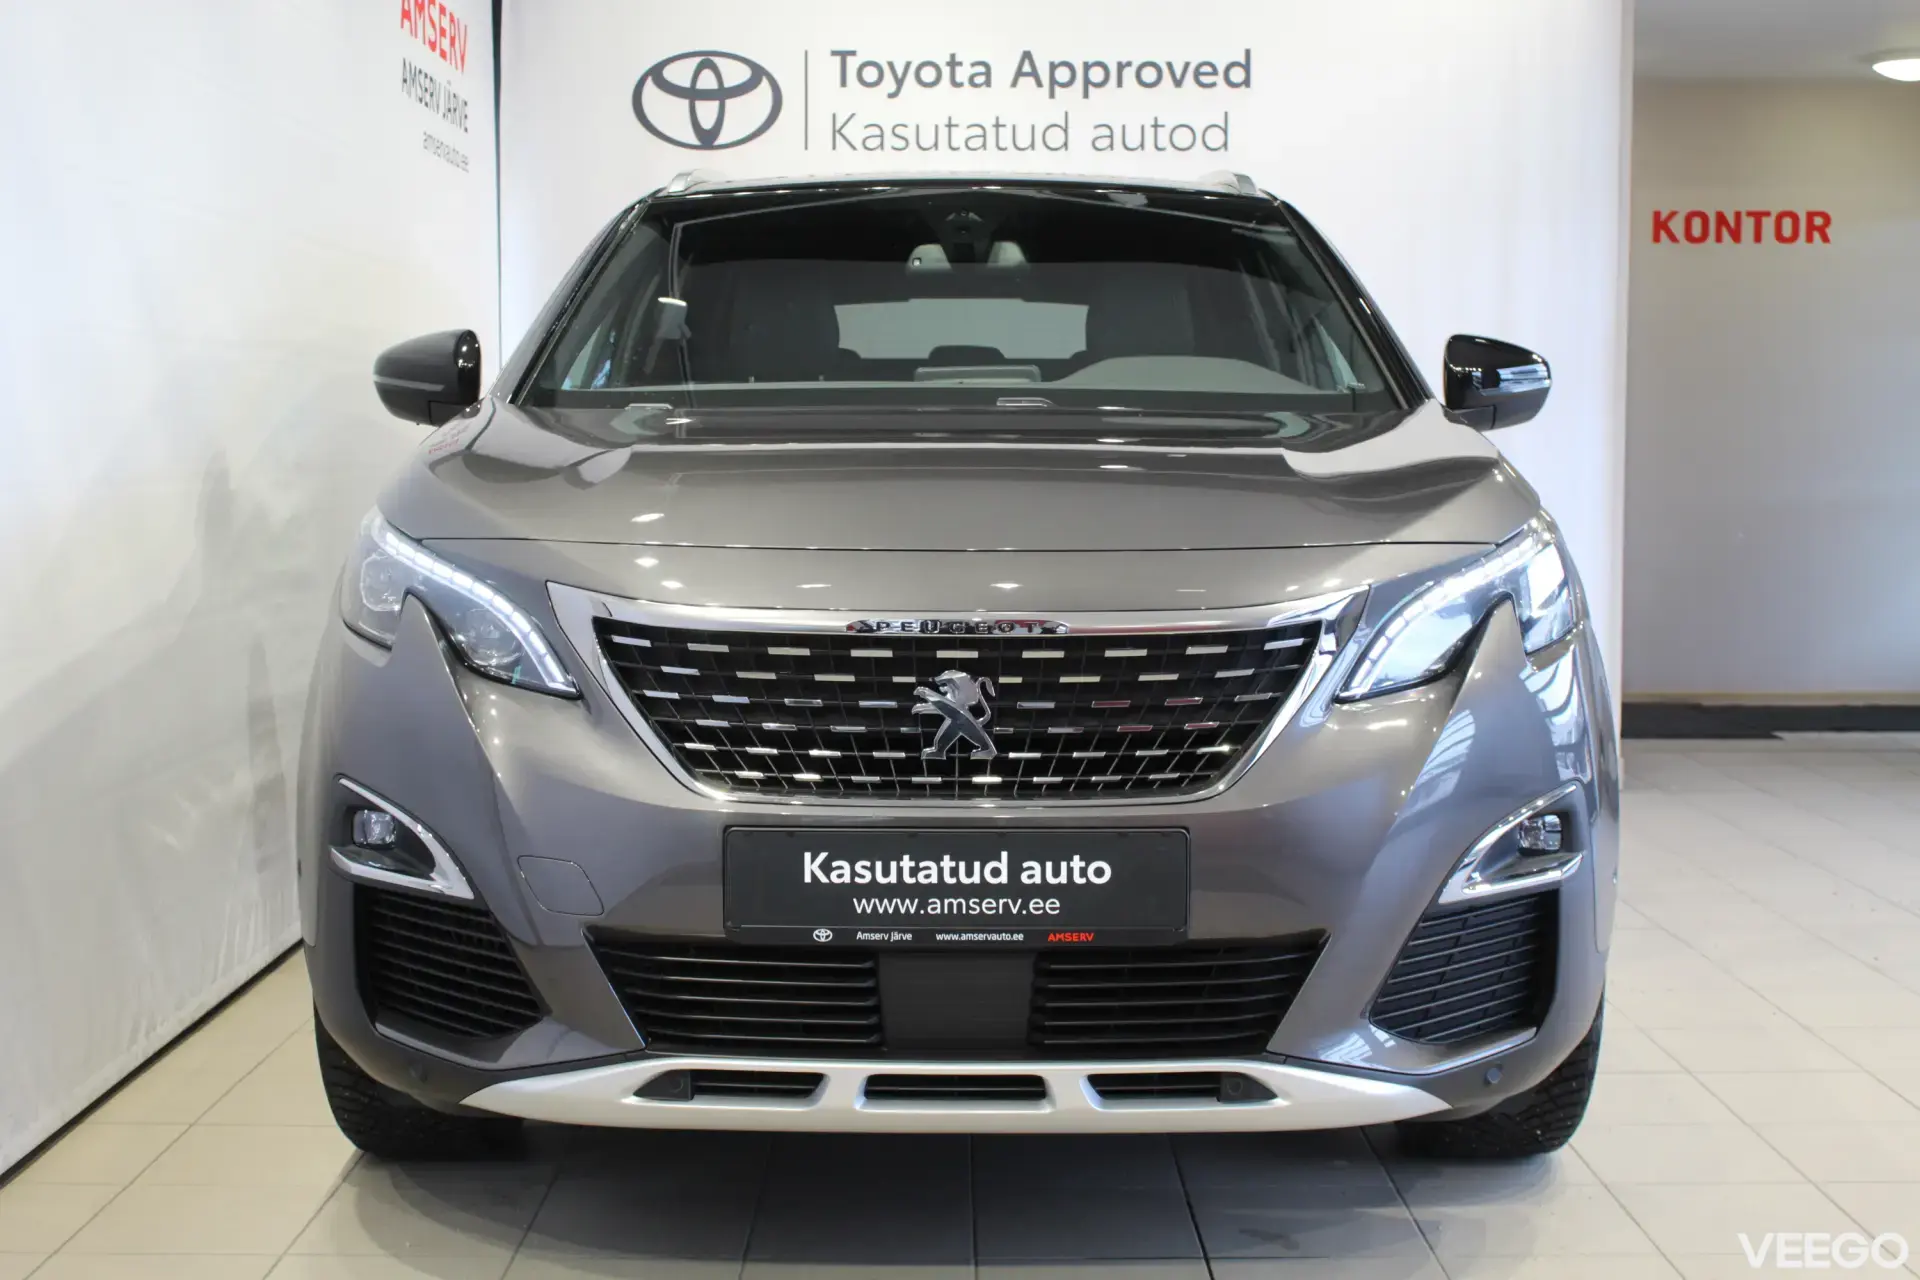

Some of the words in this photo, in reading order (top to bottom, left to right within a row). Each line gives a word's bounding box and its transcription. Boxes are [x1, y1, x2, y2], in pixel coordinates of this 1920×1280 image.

[401, 0, 467, 74] AMSERV
[402, 58, 441, 114] AMSERV
[830, 50, 992, 98] Toyota
[1010, 49, 1252, 99] Approved
[831, 111, 1070, 152] Kasutatud
[1091, 112, 1230, 152] autod
[1652, 210, 1832, 244] KONTOR
[876, 621, 1040, 634] PEUGEOT
[803, 851, 1008, 884] Kasutatud
[1020, 854, 1112, 885] auto
[853, 897, 1061, 915] www.amserv.ee
[856, 931, 889, 942] Amserv
[936, 931, 1024, 942] www.amservauto.ee
[1047, 932, 1095, 942] AMSERV
